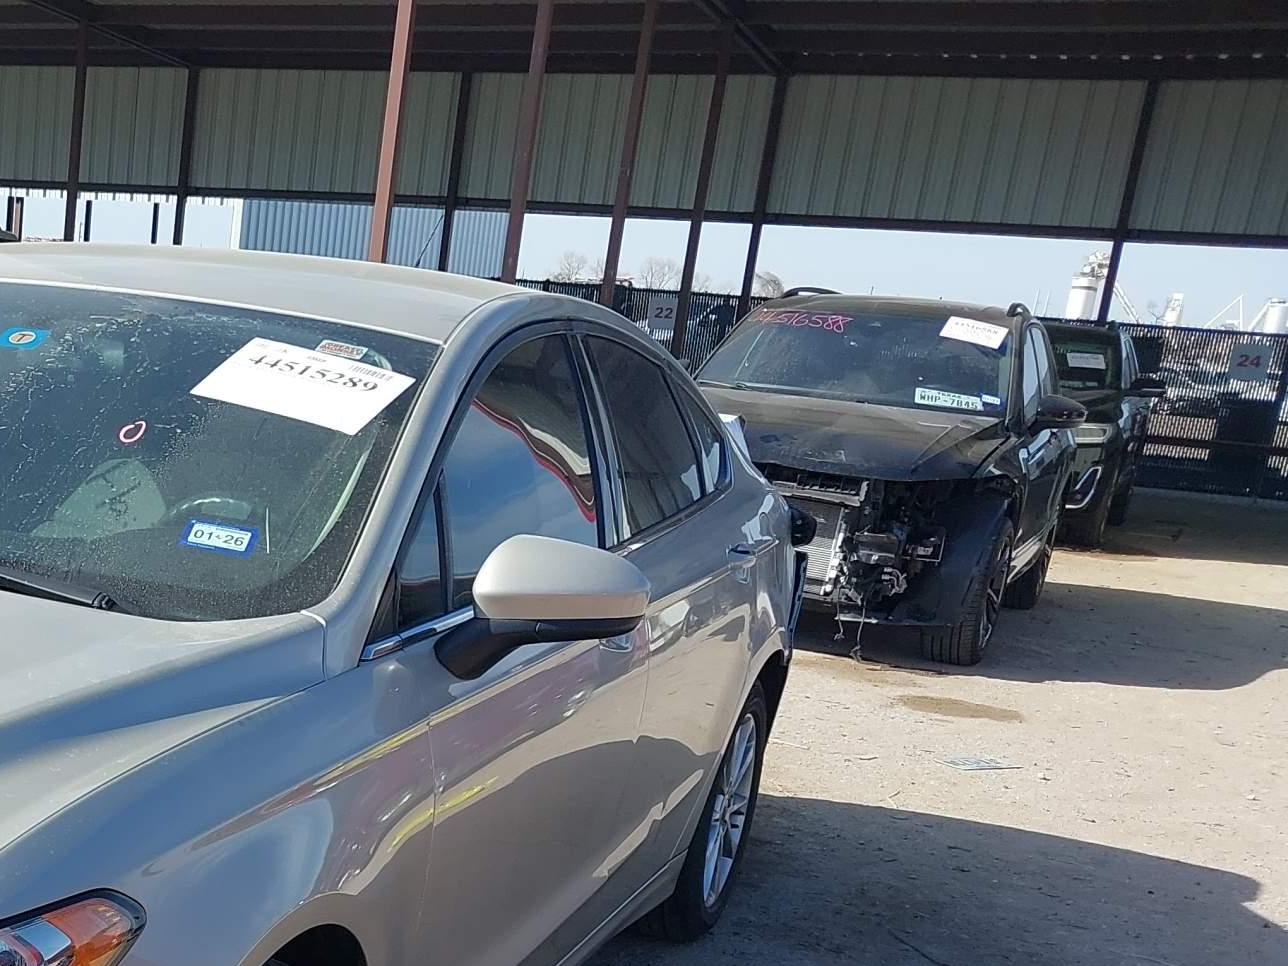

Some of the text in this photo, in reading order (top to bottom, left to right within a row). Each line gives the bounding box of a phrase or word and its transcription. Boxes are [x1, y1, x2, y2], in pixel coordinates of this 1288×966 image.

[654, 306, 673, 319] 22
[1236, 354, 1261, 368] 24
[248, 354, 379, 392] 44515289
